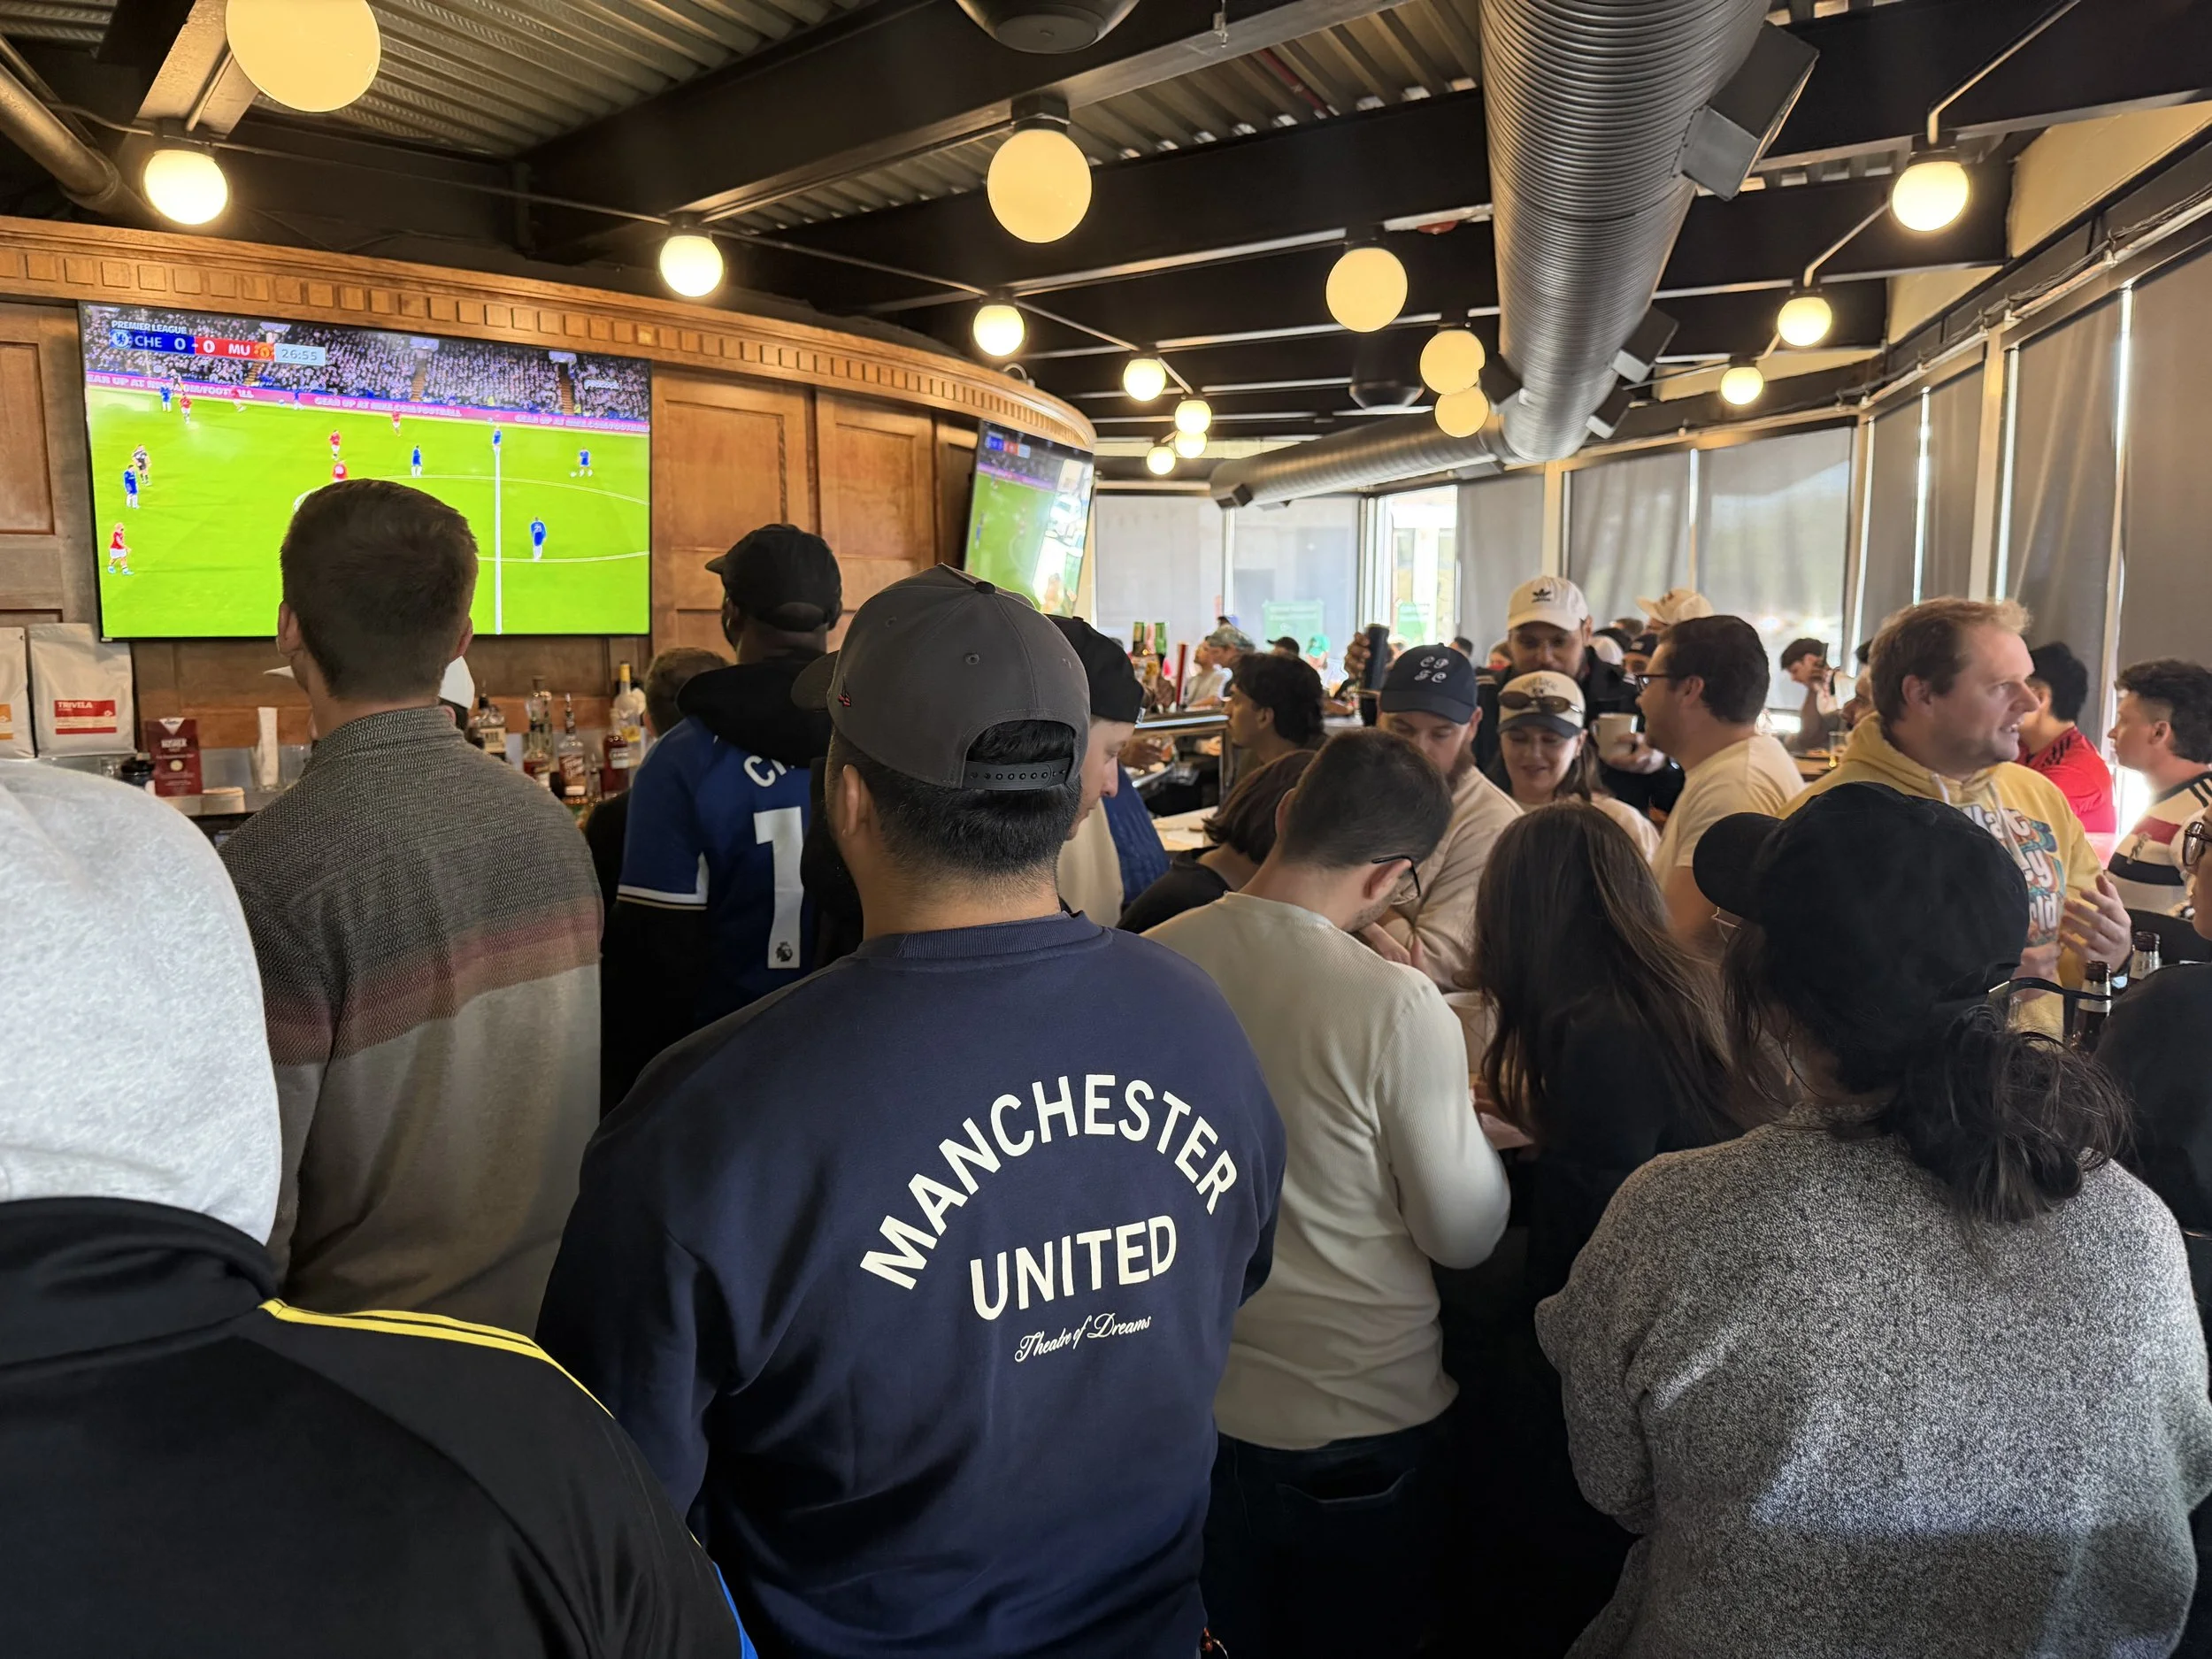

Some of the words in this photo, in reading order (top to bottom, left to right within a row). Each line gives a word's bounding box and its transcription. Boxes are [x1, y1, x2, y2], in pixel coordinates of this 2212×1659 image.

[111, 319, 150, 332] PREMIER
[151, 324, 187, 334] LEAGUE
[134, 336, 162, 348] CHE
[173, 337, 186, 350] 0
[203, 339, 216, 353] 0
[228, 343, 250, 356] MU
[281, 349, 318, 361] 26:55
[860, 1073, 1238, 1291] MANCHESTER
[970, 1215, 1177, 1320] UNITED
[1014, 1329, 1072, 1363] Theatre
[1072, 1315, 1093, 1350] of
[1087, 1312, 1152, 1339] Dreams
